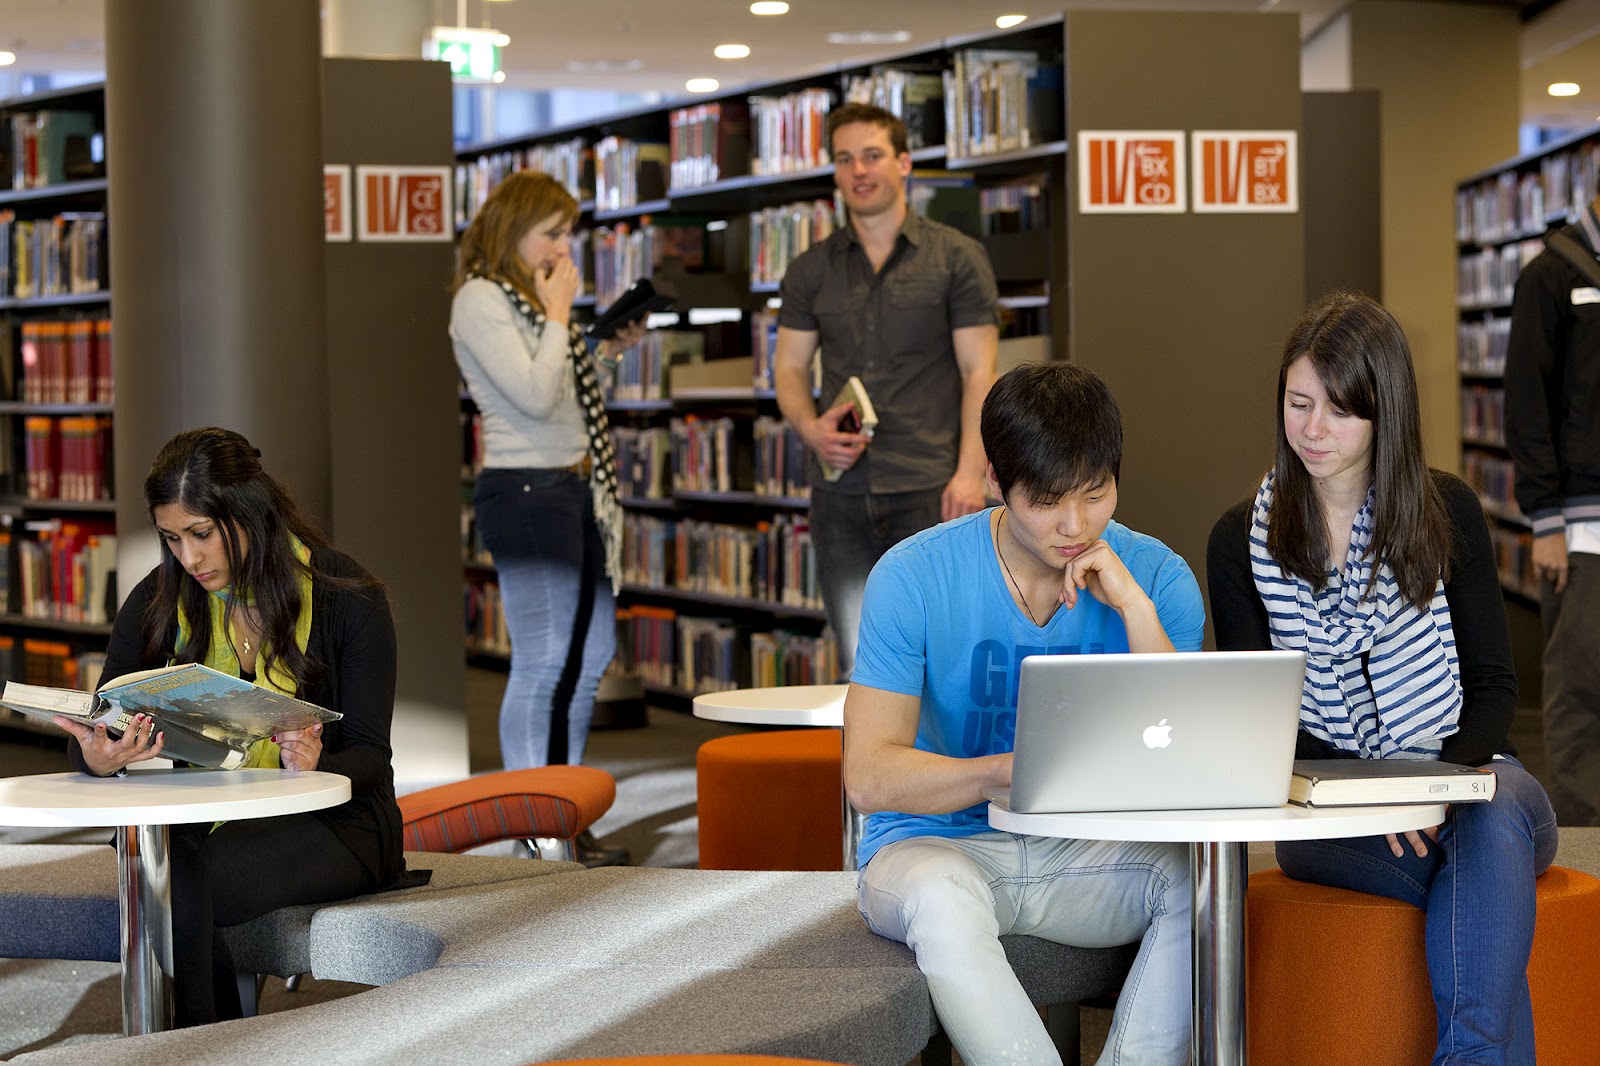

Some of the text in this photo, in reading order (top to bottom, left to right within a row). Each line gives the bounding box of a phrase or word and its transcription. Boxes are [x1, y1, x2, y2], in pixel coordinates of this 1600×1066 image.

[1141, 155, 1168, 177] BX
[1254, 155, 1280, 177] BT
[1139, 182, 1171, 205] CD
[1254, 182, 1280, 205] BX
